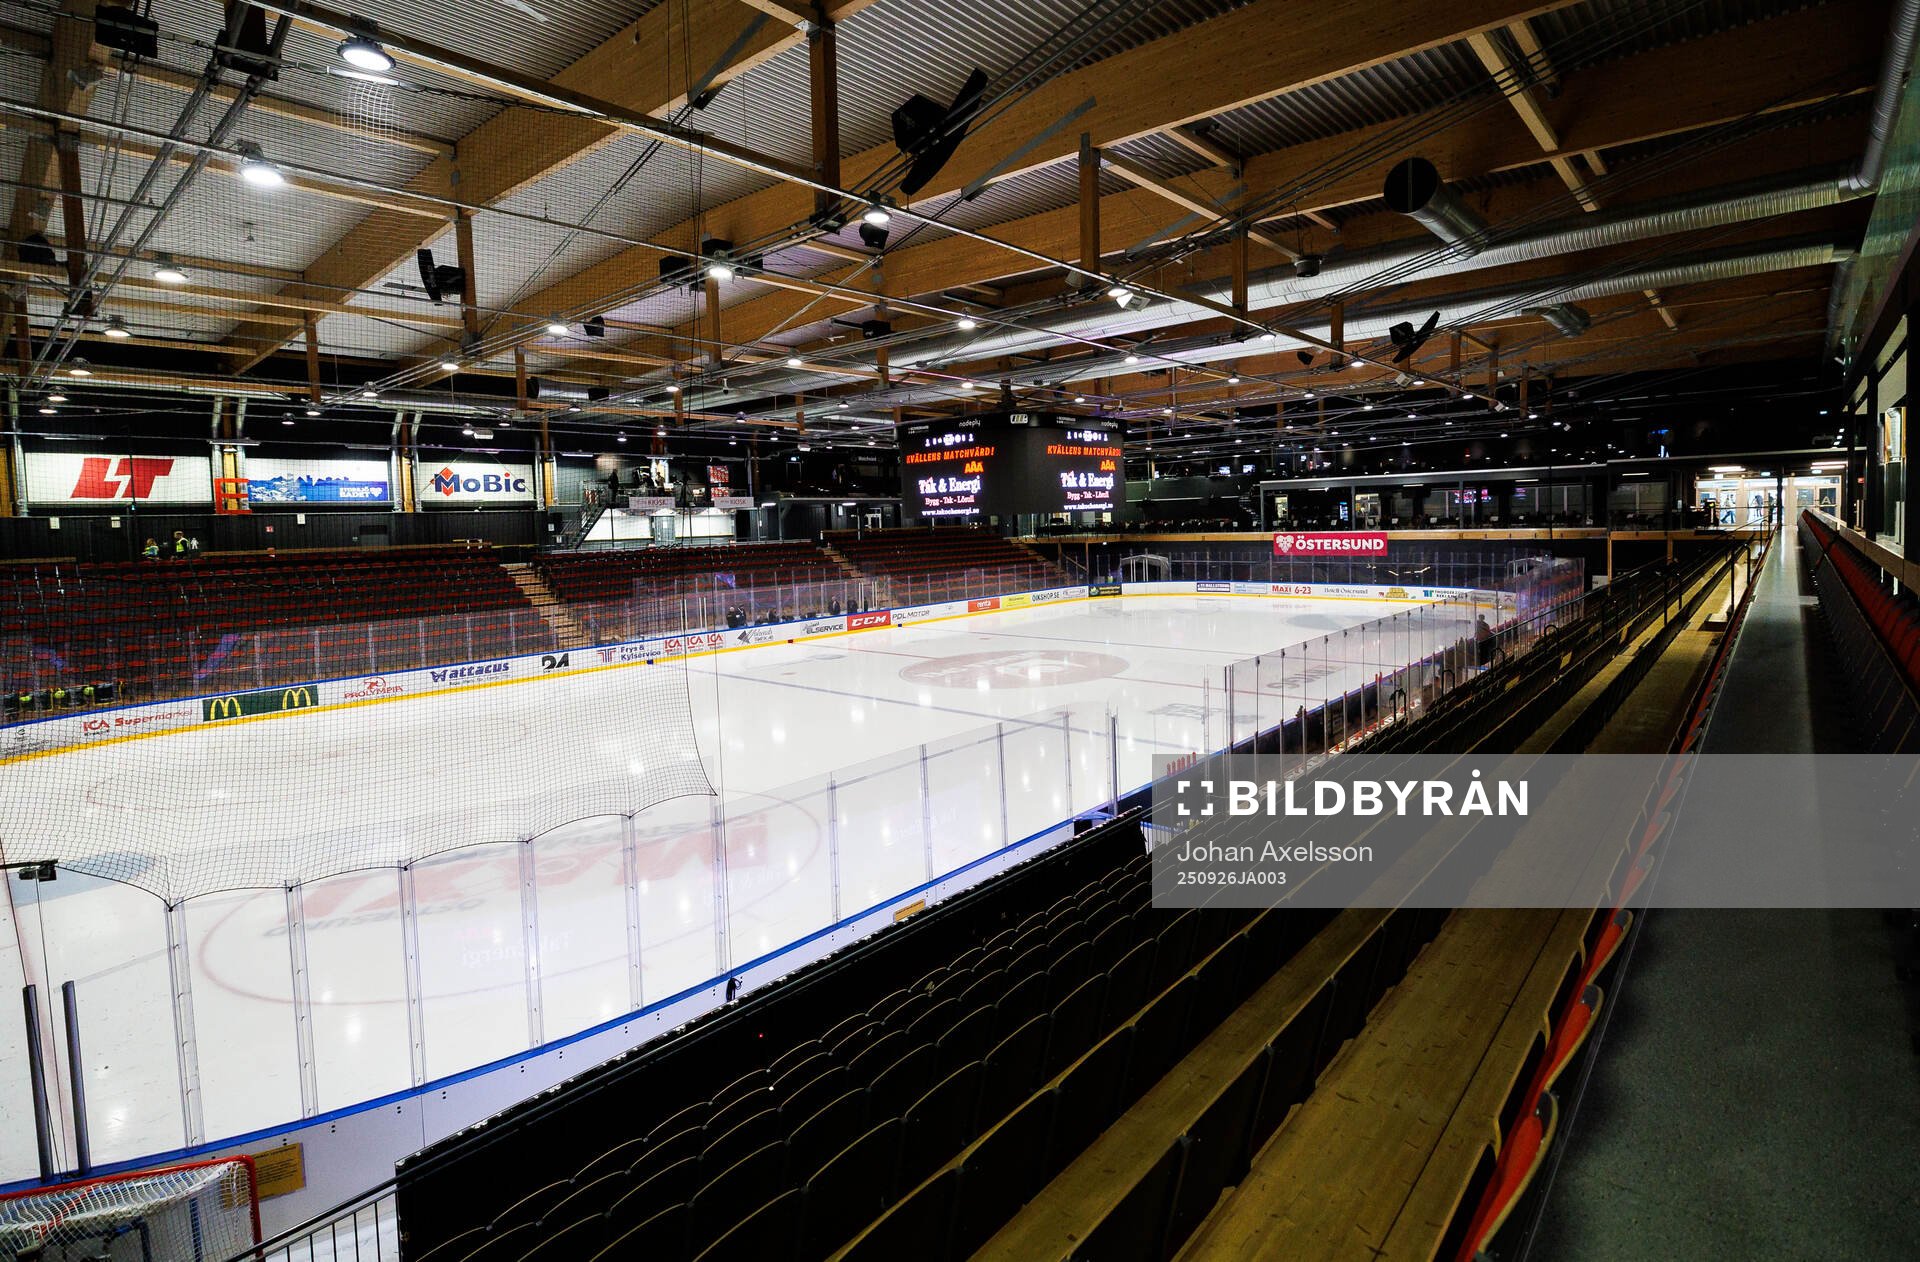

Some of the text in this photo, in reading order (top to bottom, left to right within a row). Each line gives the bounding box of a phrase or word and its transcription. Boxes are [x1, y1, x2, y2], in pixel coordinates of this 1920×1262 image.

[906, 447, 995, 464] KVÄLLENS MATCHVÄRD!
[1047, 445, 1081, 455] KVÄLLENS
[433, 470, 526, 495] MoBic
[938, 478, 947, 493] &
[948, 475, 981, 494] Energi
[1079, 472, 1087, 487] &
[1088, 473, 1114, 489] Energi
[925, 498, 940, 506] Bygg
[1295, 535, 1385, 550] ÖSTERSUND
[1294, 586, 1312, 594] 6-23
[851, 615, 887, 627] CCM
[806, 624, 844, 635] ELSERVICE
[686, 635, 703, 646] ICA
[707, 633, 724, 643] ICA
[664, 639, 682, 649] ICA
[621, 650, 661, 660] Kylservice
[82, 719, 110, 732] ICA
